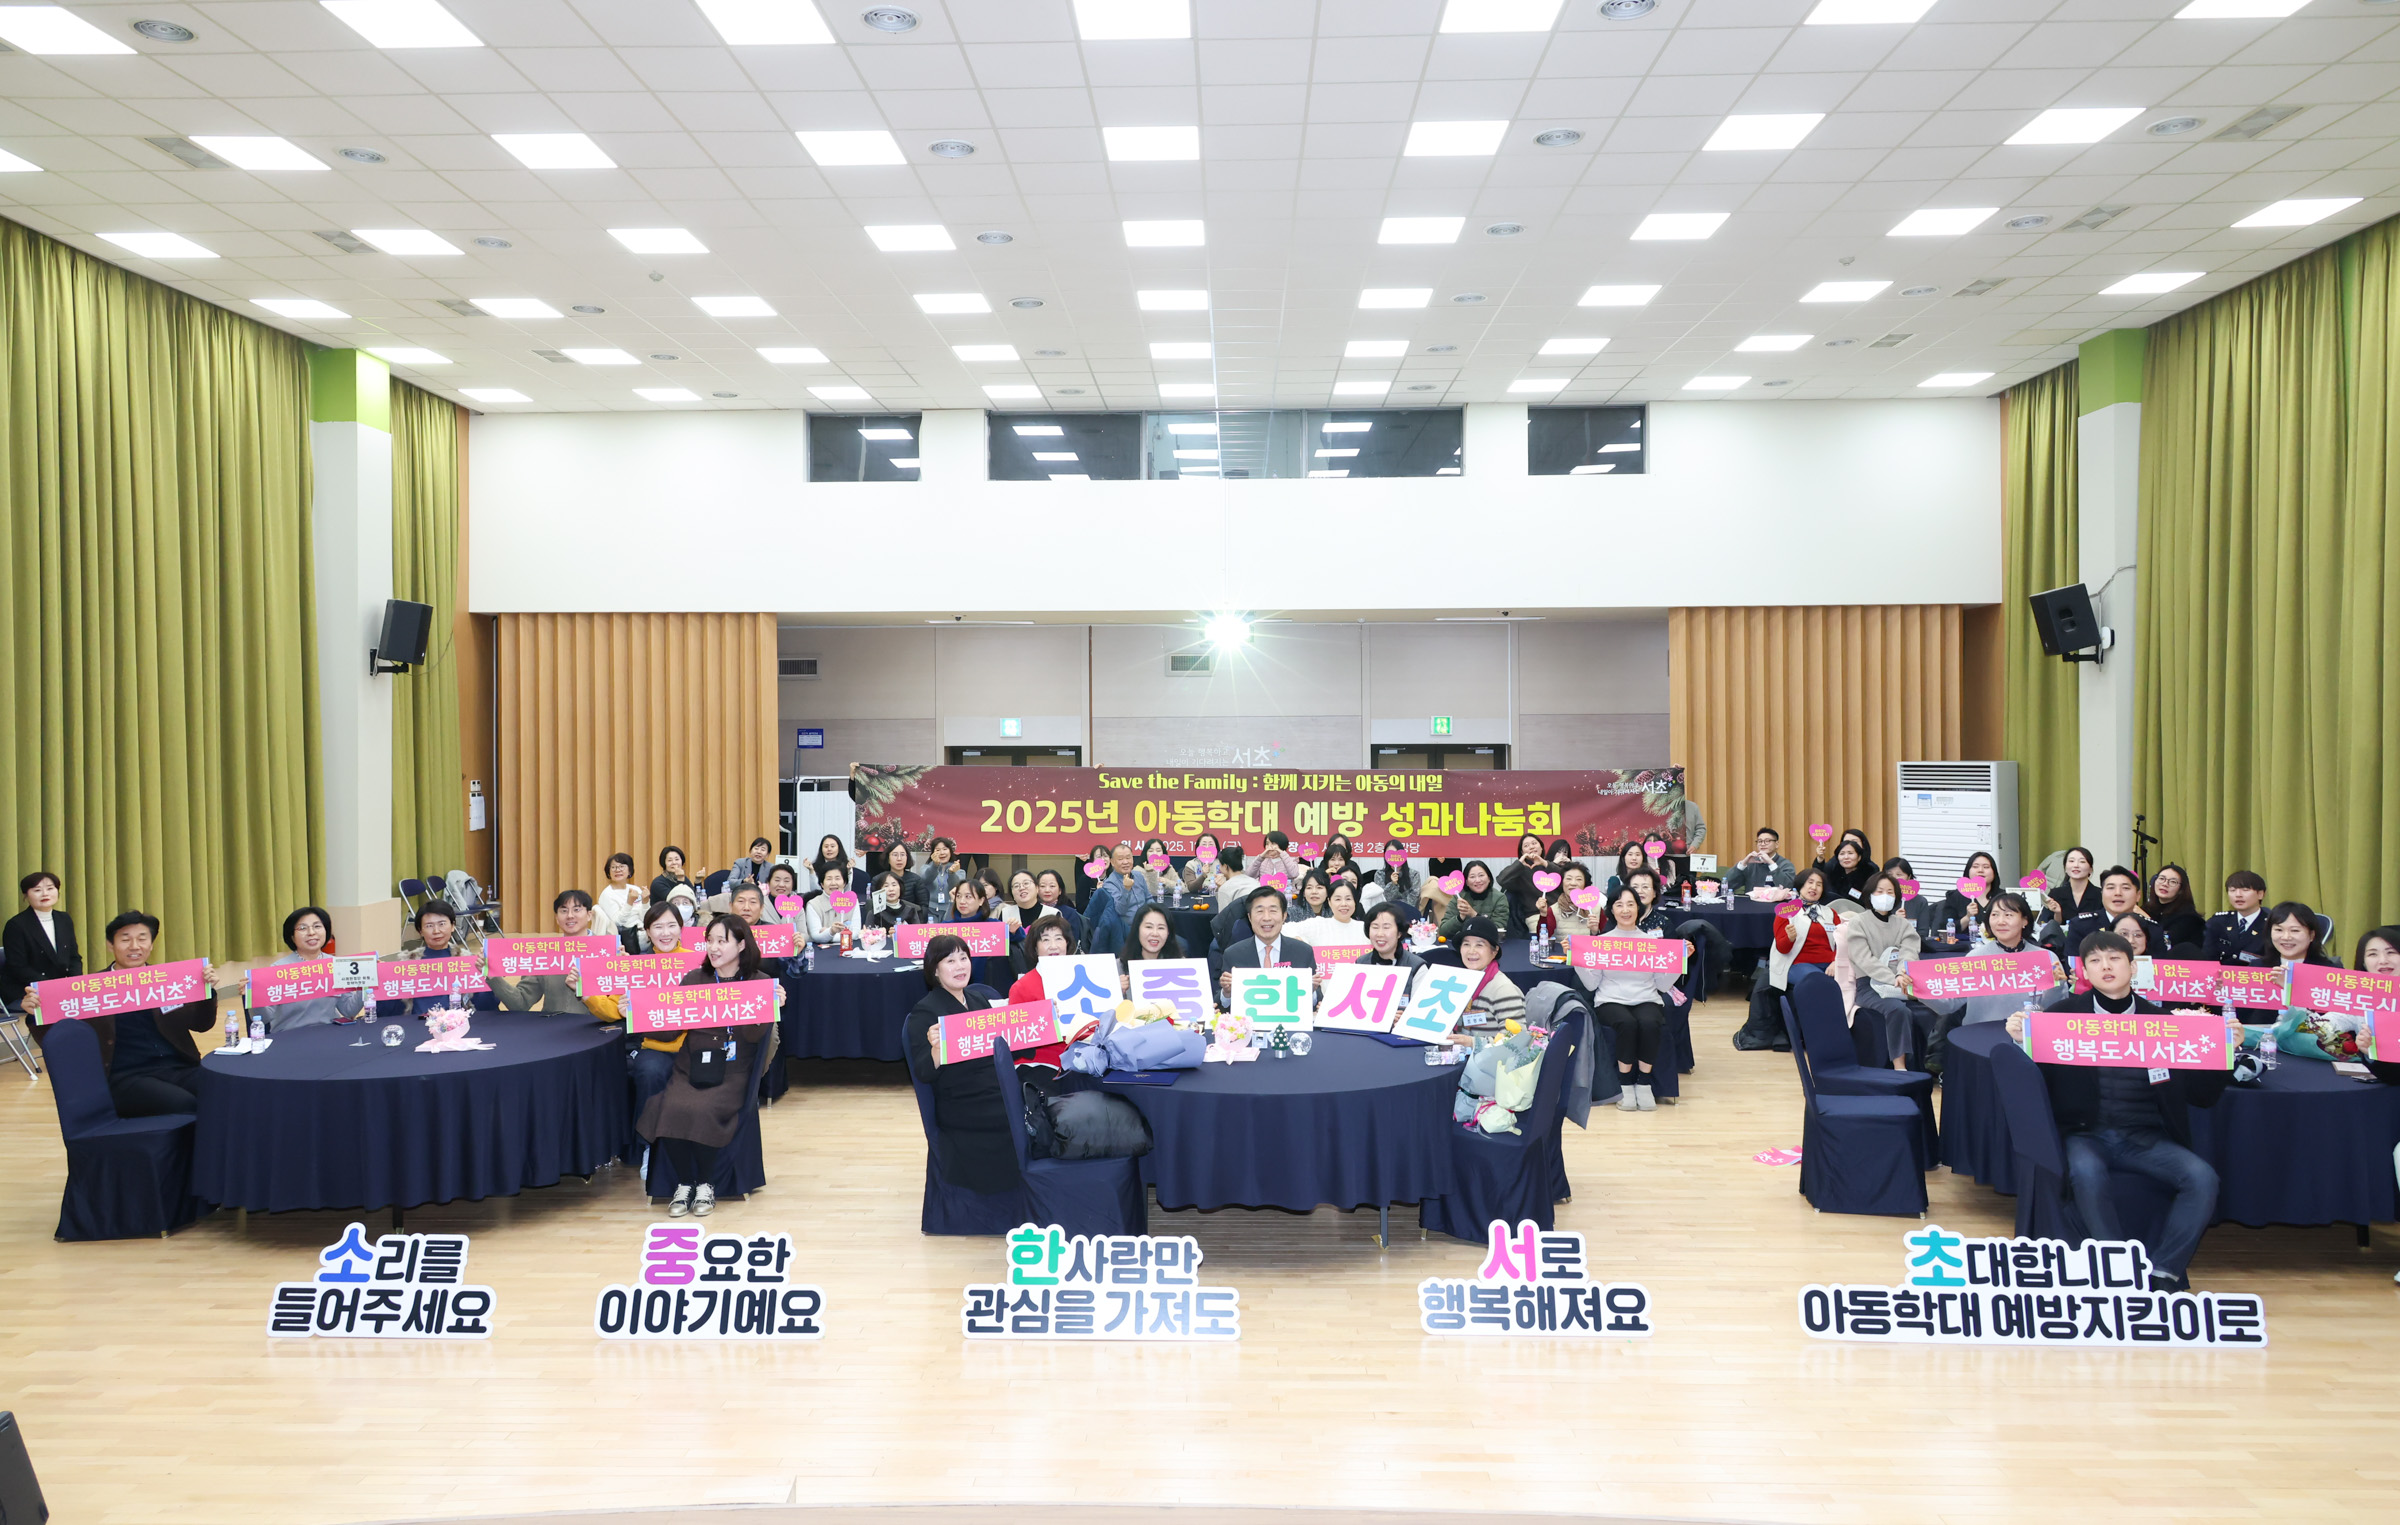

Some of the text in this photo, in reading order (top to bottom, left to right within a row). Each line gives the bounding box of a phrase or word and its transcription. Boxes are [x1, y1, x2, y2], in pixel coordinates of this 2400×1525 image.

[1231, 745, 1272, 768] 서초
[1098, 773, 1144, 789] Save
[1147, 773, 1180, 789] the
[1183, 773, 1248, 793] Family
[1262, 773, 1298, 791] 함께
[1301, 774, 1352, 791] 지키는
[1355, 774, 1406, 792] 아동의
[1409, 774, 1443, 792] 내일
[1641, 779, 1669, 794] 서초
[980, 800, 1562, 838] 2025년 아동학대 예방 성과나눔회
[1699, 857, 1707, 866] 7
[917, 925, 981, 938] 아동학대 없는
[511, 940, 588, 954] 아동학대 없는
[1321, 948, 1361, 960] 아동학대
[1592, 938, 1658, 953] 아동학대 없는
[349, 961, 360, 976] 3
[393, 960, 472, 977] 아동학대 없는
[501, 954, 565, 974] 행복도시
[606, 958, 657, 972] 아동학대
[660, 957, 685, 970] 없는
[1583, 950, 1669, 970] 행복도시 서초
[1934, 958, 2018, 975] 아동학대 없는
[2162, 964, 2191, 978] 없는
[71, 968, 168, 994] 아동학대 없는
[276, 963, 324, 981] 아동학대
[596, 973, 662, 993] 행복도시
[1925, 969, 2037, 997] 행복도시 서초
[2326, 972, 2393, 994] 아동학대
[266, 976, 329, 1003] 행복도시
[383, 978, 448, 998] 행복도시
[658, 988, 742, 1005] 아동학대 없는
[2168, 979, 2207, 998] 서초
[59, 987, 141, 1019] 행복도시
[145, 981, 187, 1003] 서초
[1242, 974, 1307, 1024] 한
[1327, 971, 1398, 1024] 서
[1405, 975, 1459, 1034] 초
[2310, 986, 2397, 1013] 행복도시
[647, 1000, 757, 1029] 행복도시 서초
[966, 1009, 1029, 1031] 아동학대 없는
[1013, 1022, 1042, 1043] 서초
[2066, 1018, 2180, 1038] 아동학대 없는
[2051, 1038, 2202, 1065] 행복도시 서초
[319, 1227, 464, 1285] 소리를
[644, 1227, 791, 1285] 중요한
[1011, 1228, 1199, 1286] 한사람만
[1483, 1225, 1584, 1282] 서로
[1910, 1230, 2148, 1292] 초대합니다
[273, 1286, 491, 1334] 들어주세요
[599, 1288, 821, 1336] 이야기예요
[965, 1286, 1240, 1336] 관심을 가져도
[1423, 1283, 1650, 1332] 행복해져요
[1804, 1288, 2263, 1343] 아동학대 예방지킴이로
